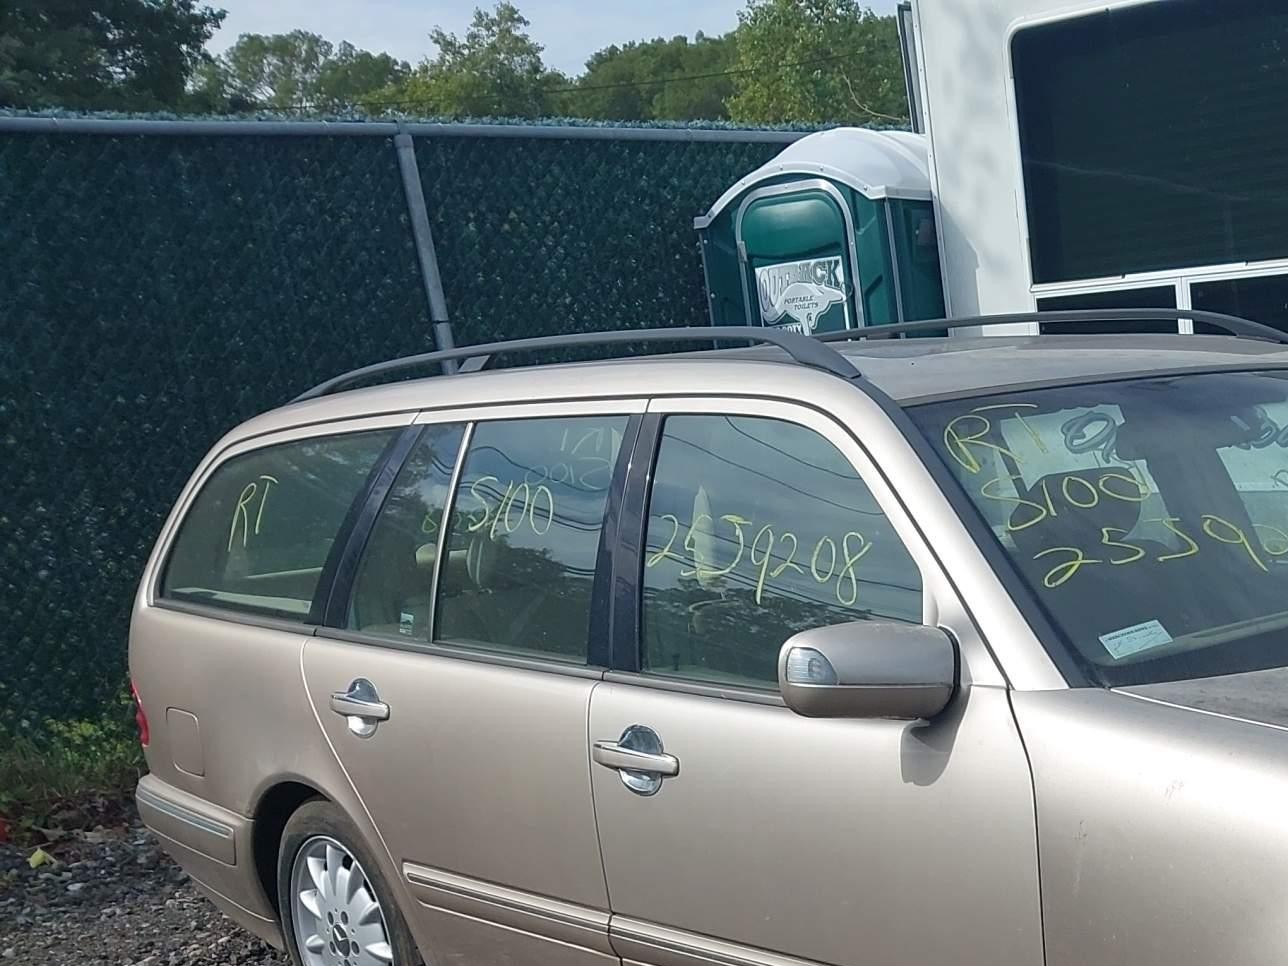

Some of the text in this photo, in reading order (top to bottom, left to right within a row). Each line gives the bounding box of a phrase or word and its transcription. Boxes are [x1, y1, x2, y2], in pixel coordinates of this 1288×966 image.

[794, 302, 819, 311] TOILETS
[227, 475, 279, 553] RT
[469, 476, 554, 540] S100
